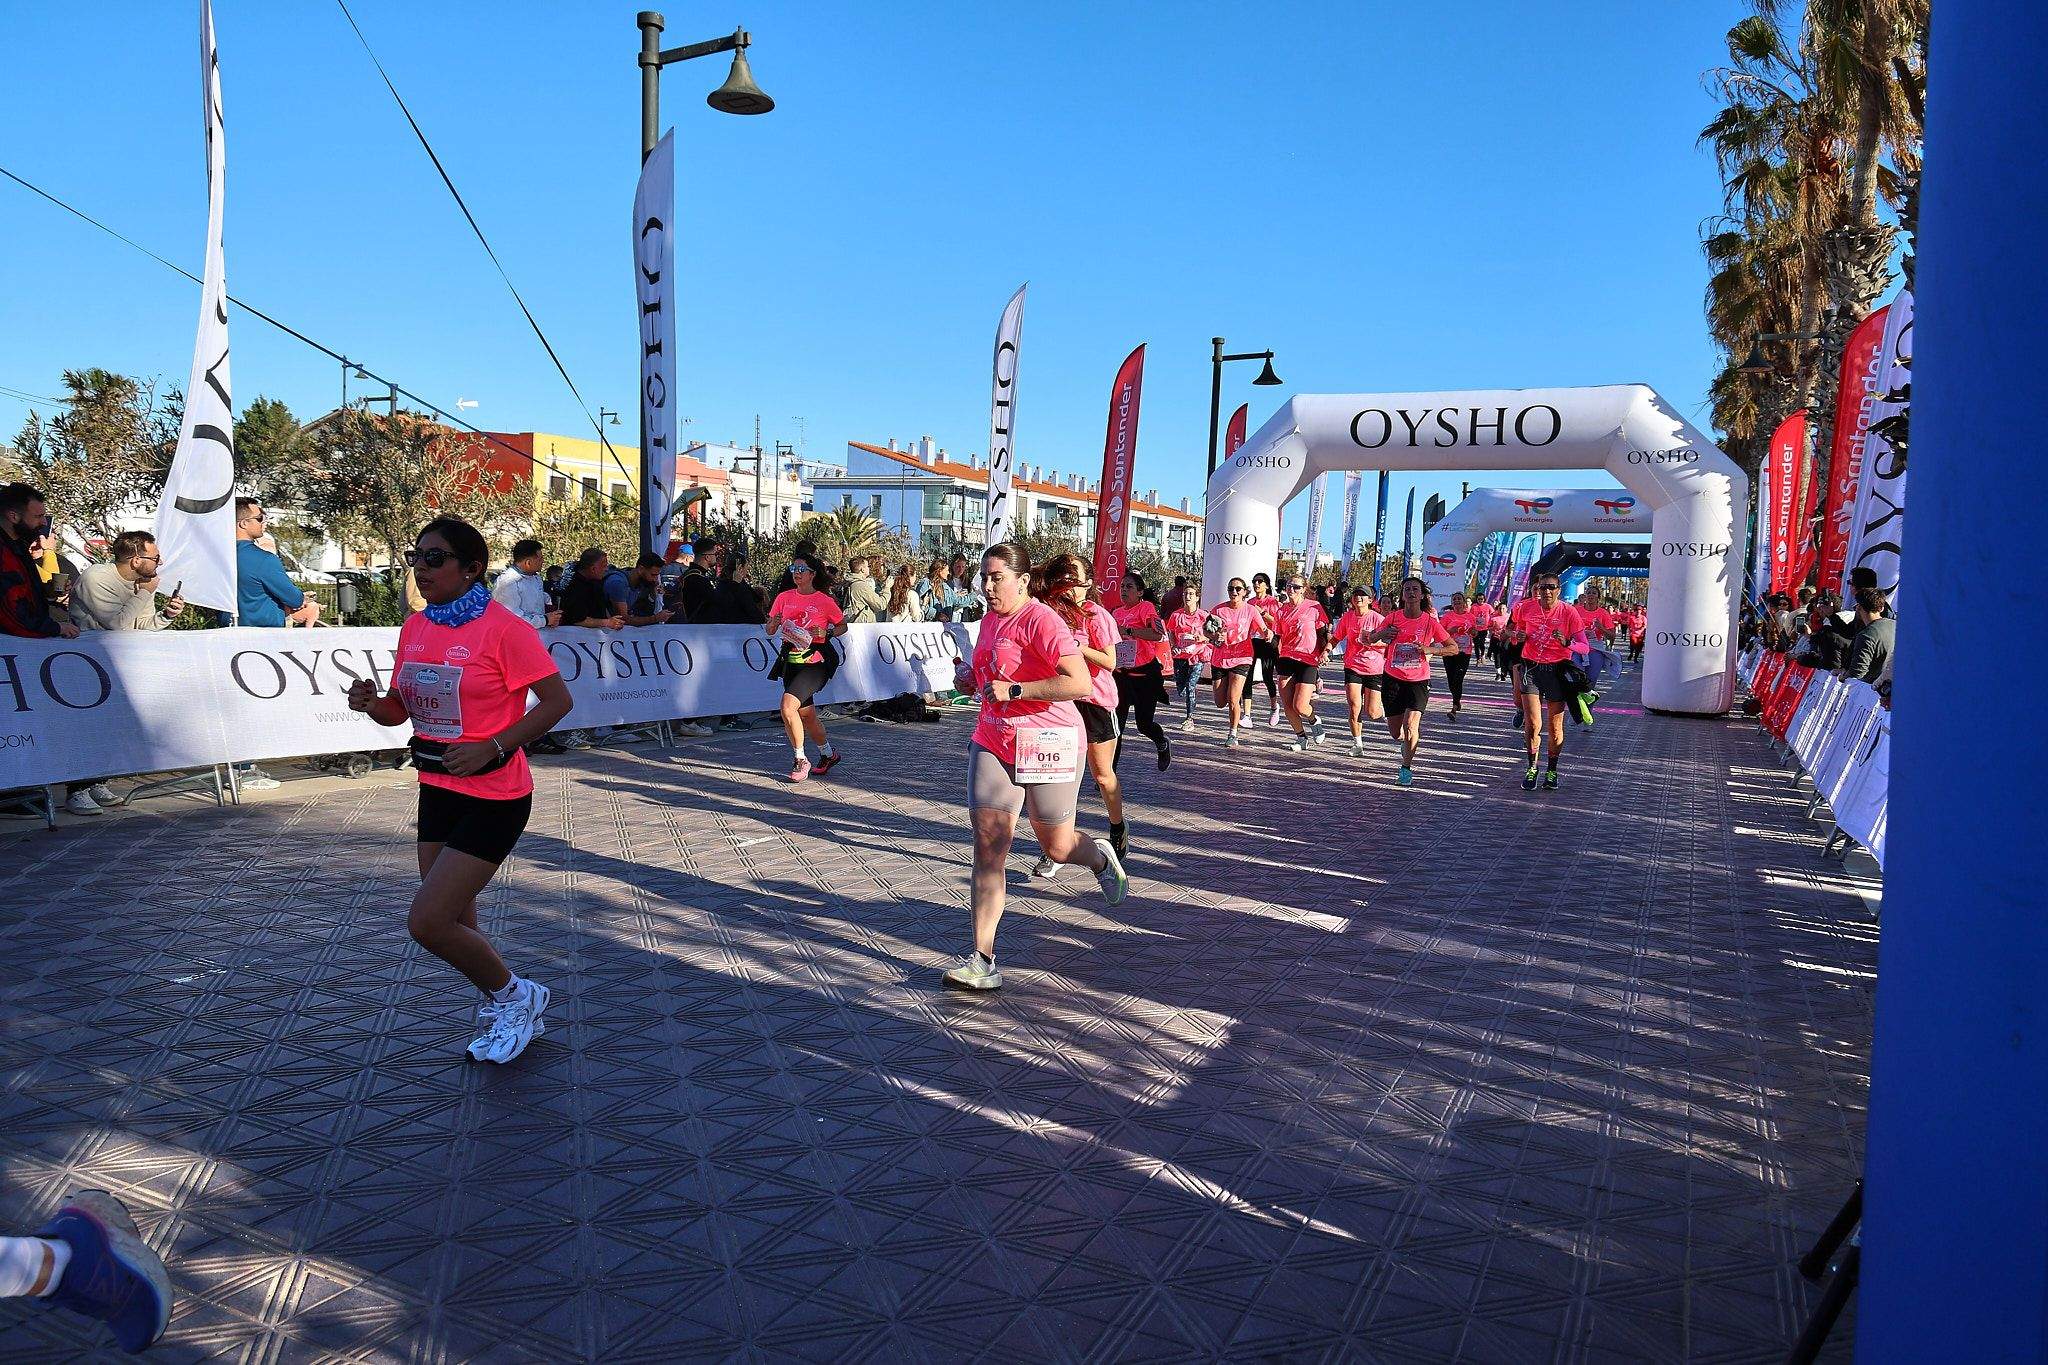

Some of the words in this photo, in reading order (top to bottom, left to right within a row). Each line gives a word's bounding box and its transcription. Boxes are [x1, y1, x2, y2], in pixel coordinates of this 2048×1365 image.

[1350, 404, 1562, 449] OYSHO
[1840, 345, 1883, 493] Santander
[1235, 455, 1291, 469] OYSHO
[1627, 449, 1699, 465] OYSHO
[1102, 526, 1120, 592] Sports
[1111, 382, 1133, 492] Santander
[1778, 443, 1793, 537] Santander
[1207, 533, 1257, 547] OYSHO
[1661, 542, 1729, 557] OYSHO
[878, 630, 959, 665] OYSHO
[1656, 632, 1723, 648] OYSHO
[548, 639, 693, 682] OYSHO
[230, 648, 398, 699] OYSH
[416, 695, 439, 709] 016
[1037, 752, 1060, 762] 016
